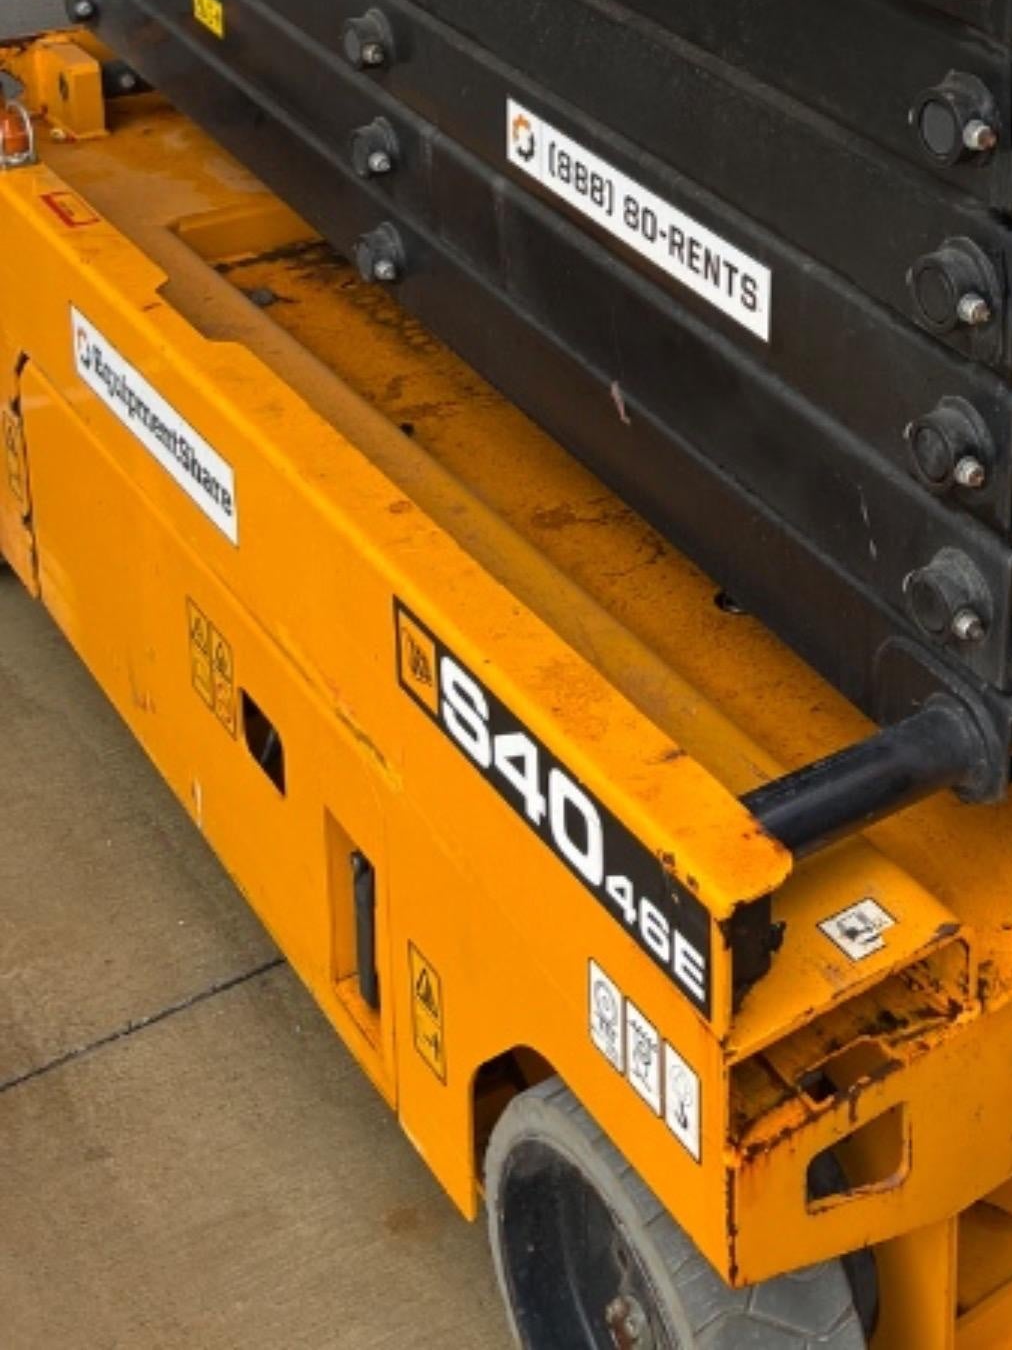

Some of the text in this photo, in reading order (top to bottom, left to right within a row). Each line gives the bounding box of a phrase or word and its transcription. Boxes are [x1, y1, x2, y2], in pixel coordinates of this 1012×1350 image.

[548, 141, 759, 314] (888) 80-RENTS
[92, 344, 233, 518] EquipmentShare
